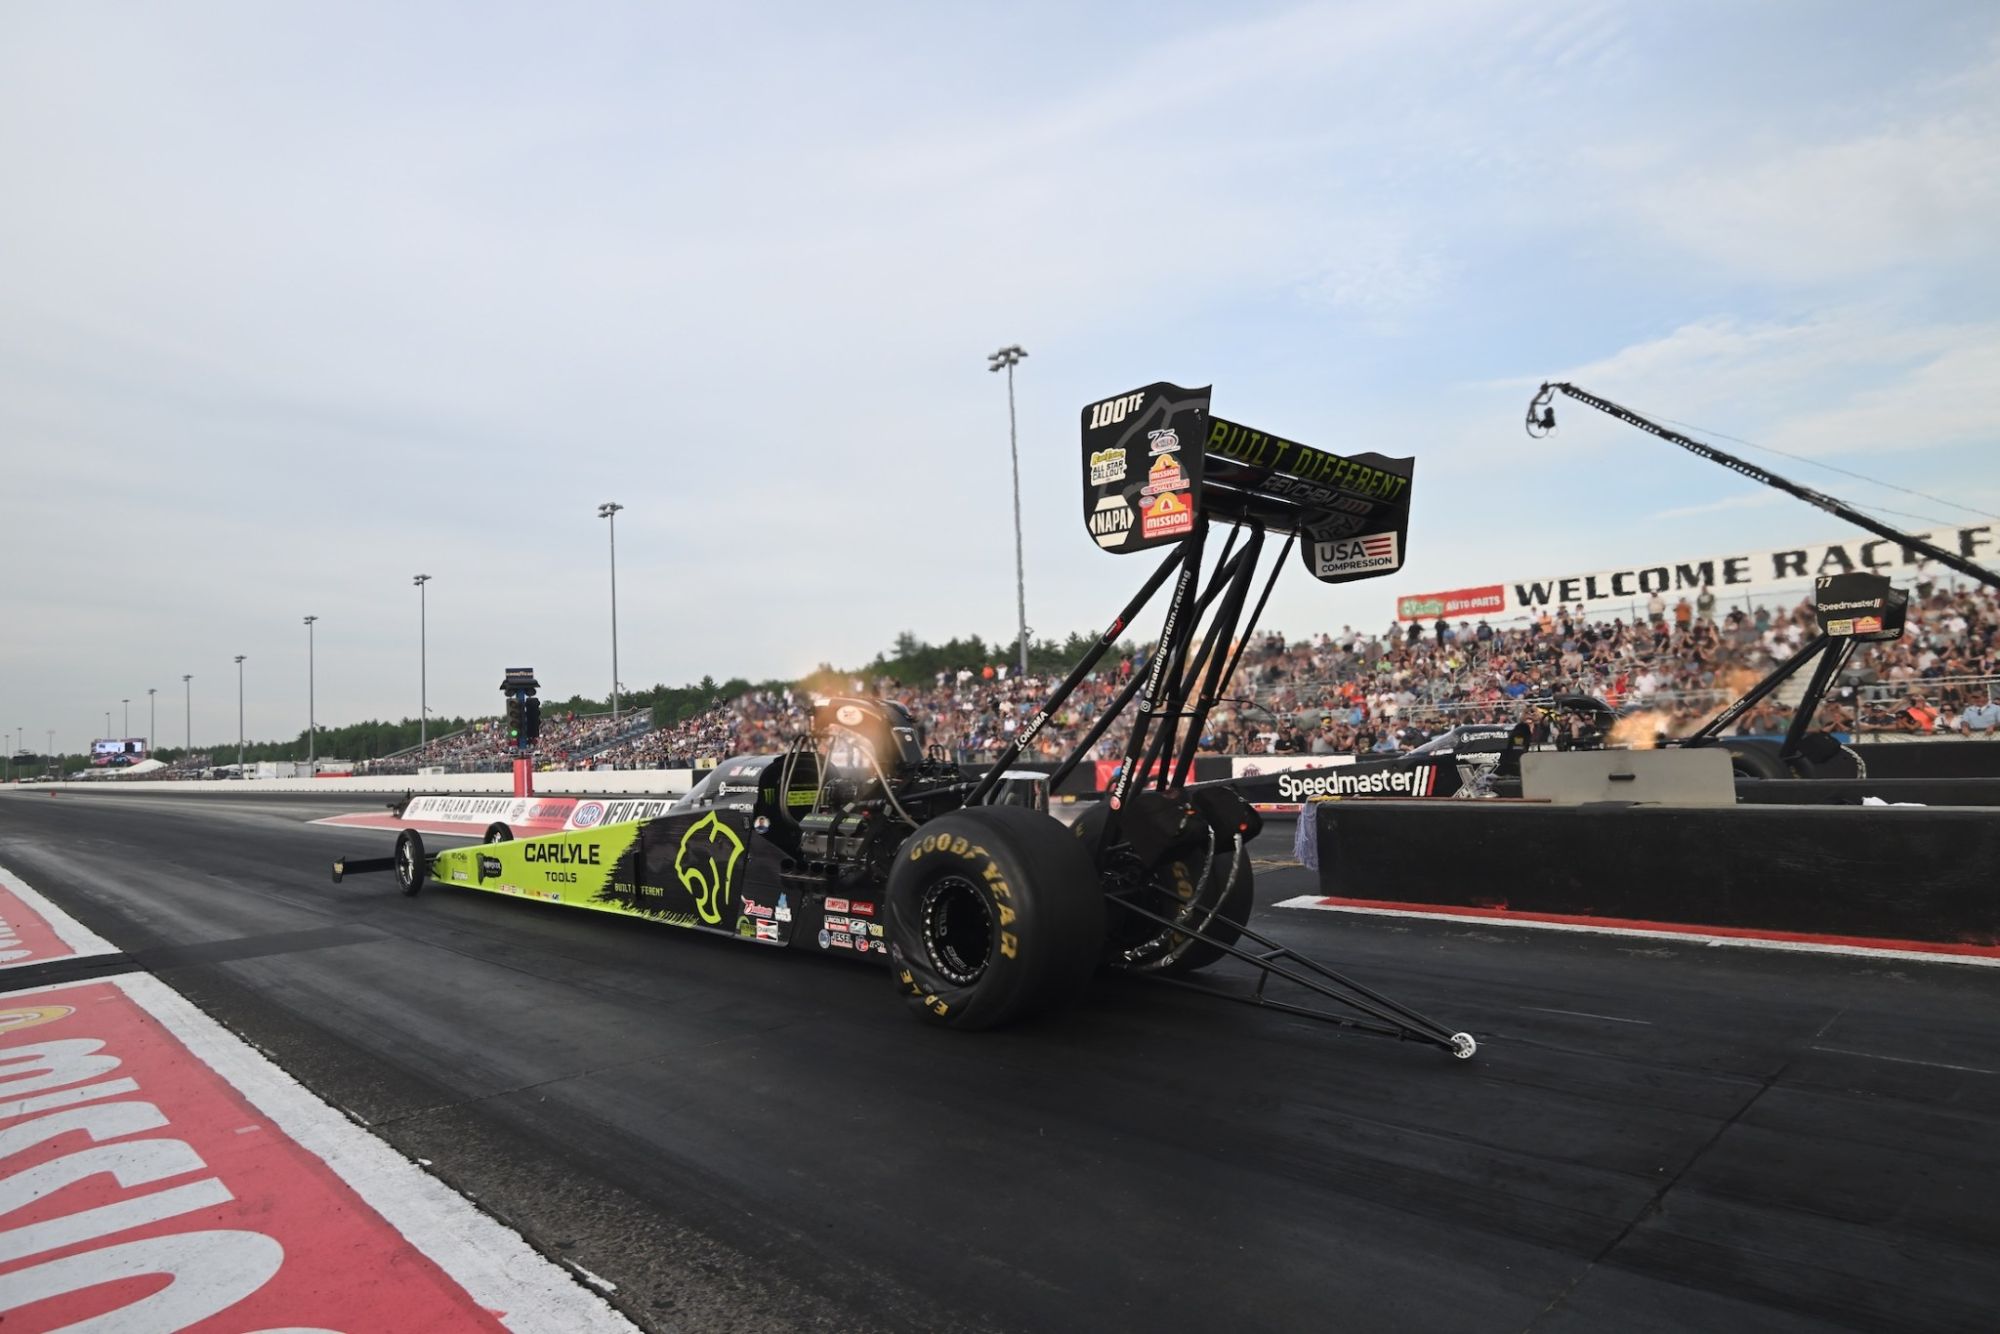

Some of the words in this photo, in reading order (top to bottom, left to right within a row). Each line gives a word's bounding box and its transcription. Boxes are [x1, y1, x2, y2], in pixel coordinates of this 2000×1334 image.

[1089, 391, 1145, 430] 100TF
[1093, 464, 1105, 473] ALL
[1107, 460, 1124, 471] STAR
[1207, 421, 1290, 468] BUILT
[1291, 447, 1407, 498] DIFFERENT
[1096, 507, 1129, 535] NAPA
[1320, 541, 1367, 563] USA
[1321, 556, 1393, 574] COMPRESSION
[1514, 556, 1752, 607] WELCOME
[1958, 526, 2000, 558] F
[1817, 576, 1833, 589] 77
[1446, 599, 1470, 612] AUTO
[1471, 595, 1500, 608] PARTS
[1817, 600, 1874, 612] Speedmaster
[1278, 769, 1414, 802] Speedmaster
[436, 799, 471, 814] ENGLAND
[471, 799, 513, 815] DRAGWAY
[524, 843, 601, 865] CARLYLE
[545, 871, 577, 883] TOOLS
[614, 883, 632, 893] BUILT
[910, 833, 1017, 959] GOODYEAR
